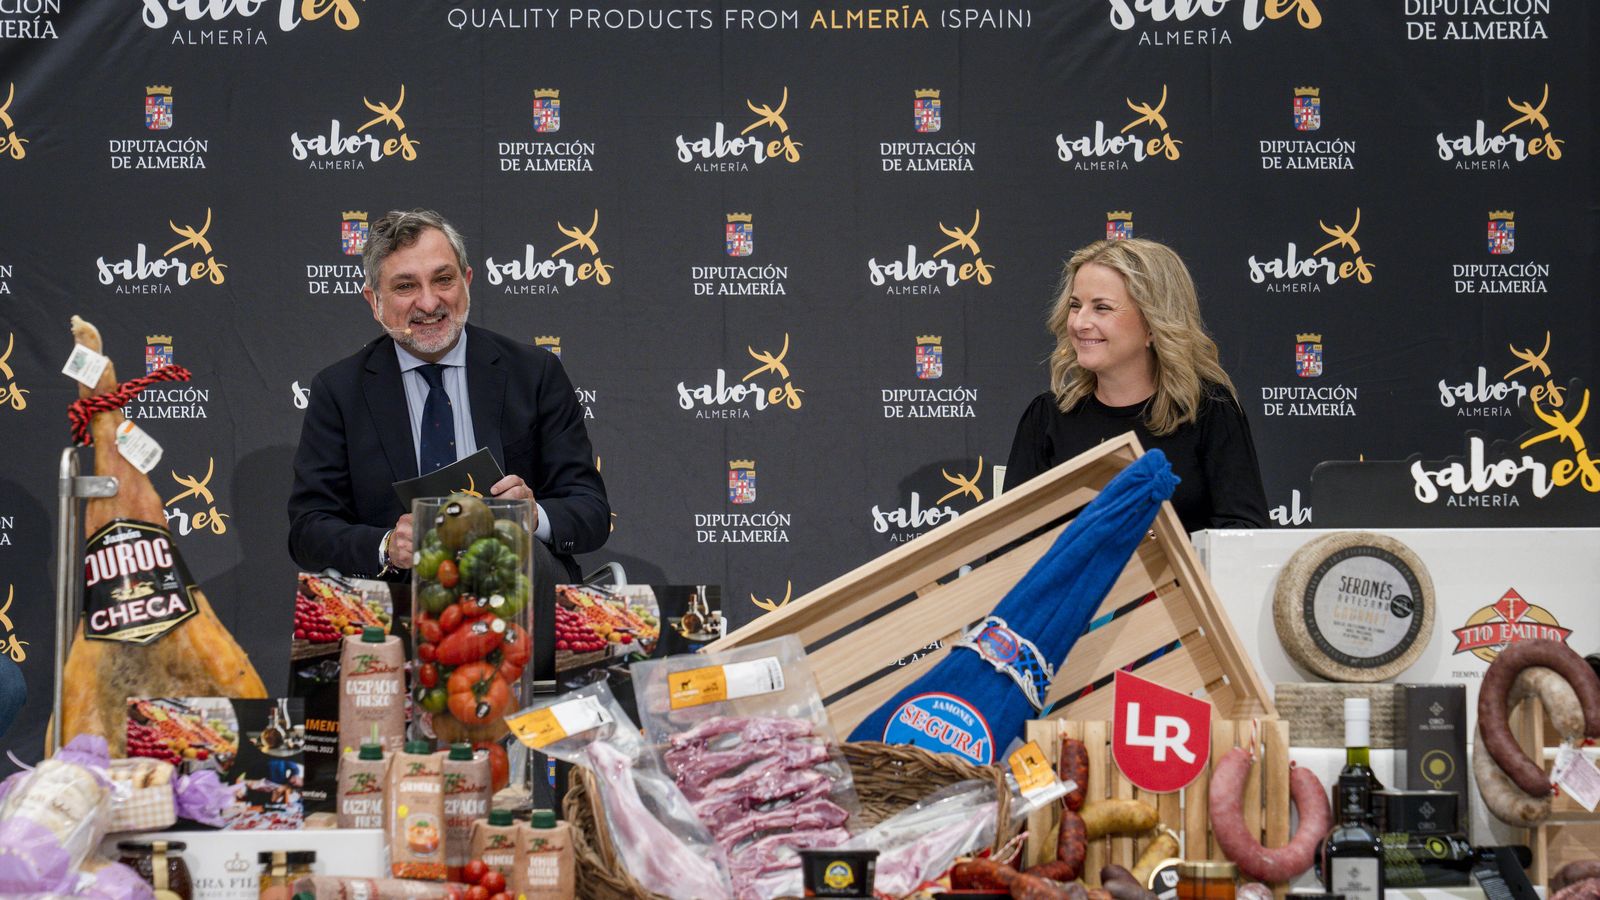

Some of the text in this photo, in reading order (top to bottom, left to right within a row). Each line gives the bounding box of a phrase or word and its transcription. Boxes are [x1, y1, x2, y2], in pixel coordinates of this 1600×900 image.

[448, 5, 1030, 29] QUALITY PRODUCTS FROM ALMERÍA (SPAIN)
[1406, 16, 1548, 40] DE ALMERÍA
[172, 28, 267, 44] ALMERÍA
[1139, 28, 1231, 45] ALMERÍA
[110, 137, 208, 152] DIPUTACIÓN
[291, 119, 420, 162] sabores
[499, 140, 594, 155] DIPUTACIÓN
[676, 121, 803, 164] sabores
[880, 140, 975, 155] DIPUTACIÓN
[1056, 121, 1183, 162] sabores
[1260, 138, 1355, 153] DIPUTACIÓN
[1437, 120, 1564, 161] sabores
[111, 153, 205, 168] DE ALMERÍA
[310, 160, 364, 169] ALMERÍA
[500, 156, 592, 171] DE ALMERÍA
[695, 162, 748, 171] ALMERÍA
[882, 156, 974, 171] DE ALMERÍA
[1075, 160, 1128, 170] ALMERÍA
[1262, 154, 1354, 169] DE ALMERÍA
[1456, 160, 1509, 169] ALMERÍA
[97, 243, 227, 286] sabores
[486, 243, 614, 286] sabores
[692, 264, 787, 279] DIPUTACIÓN
[868, 243, 995, 286] sabores
[1248, 243, 1375, 285] sabores
[1453, 261, 1549, 277] DIPUTACIÓN
[307, 266, 365, 279] DIPUTA
[116, 284, 171, 294] ALMERÍA
[309, 282, 329, 293] DE
[505, 284, 558, 294] ALMERÍA
[694, 280, 786, 295] DE ALMERÍA
[887, 285, 940, 294] ALMERÍA
[1267, 282, 1320, 292] ALMERÍA
[1455, 278, 1547, 293] DE ALMERÍA
[128, 386, 208, 402] UTACIÓN
[677, 368, 804, 411] sabores
[882, 386, 977, 401] DIPUTACIÓN
[1262, 385, 1357, 399] DIPUTACIÓN
[1439, 367, 1566, 408] sabores
[137, 403, 207, 418] ALMERÍA
[696, 409, 749, 418] ALMERÍA
[884, 402, 975, 418] DE ALMERÍA
[1264, 401, 1356, 415] DE ALMERÍA
[1458, 407, 1511, 416] ALMERÍA
[1411, 437, 1600, 503] sabores
[1447, 494, 1519, 506] ALMERÍA
[695, 511, 790, 526] DIPUTACIÓN
[871, 491, 961, 533] sabo
[697, 527, 789, 542] DE ALMERÍA
[1339, 576, 1393, 600] SERONÉS
[90, 593, 187, 631] CHECA
[1503, 598, 1520, 619] T
[1461, 625, 1493, 644] TIO
[345, 680, 399, 695] GAZPACHO
[356, 695, 391, 707] FRESCO
[932, 700, 975, 726] JAMONES
[899, 703, 983, 763] SEGURA
[1125, 702, 1196, 764] LR
[342, 799, 383, 814] GAZPAC
[444, 799, 487, 814] ZPACHO
[355, 815, 382, 828] FRES
